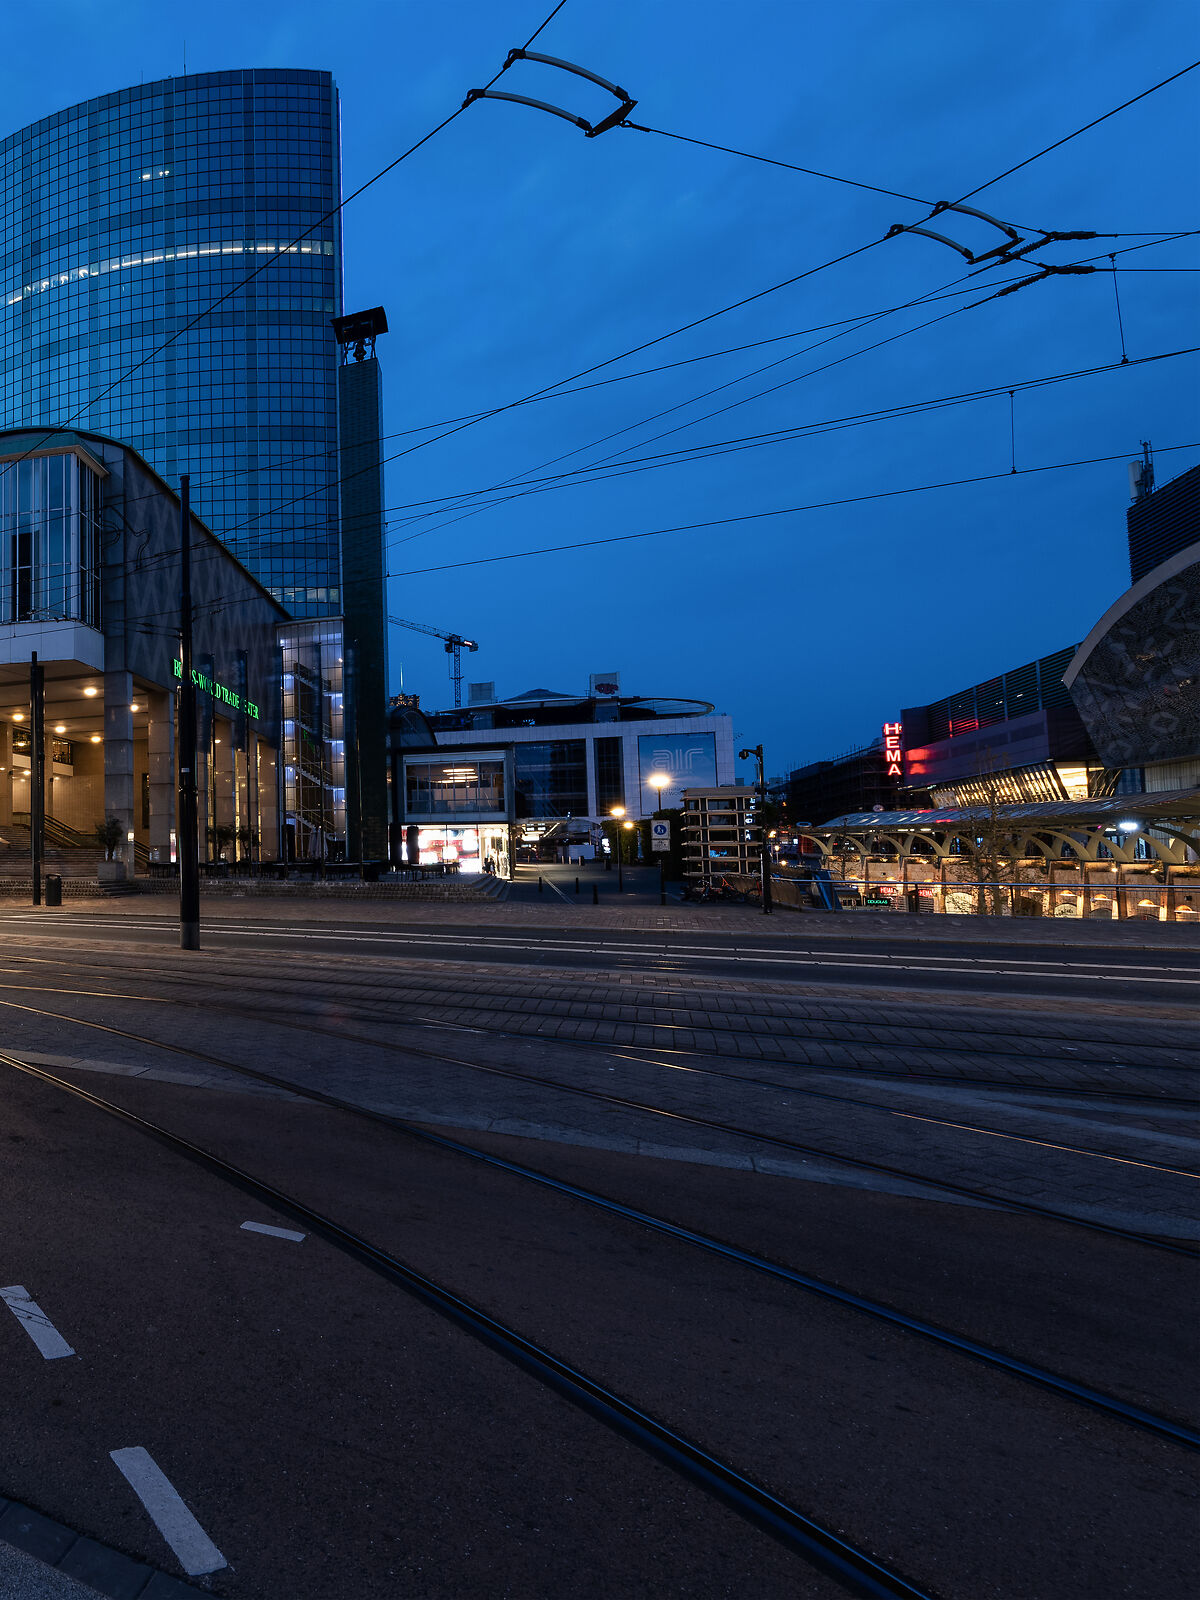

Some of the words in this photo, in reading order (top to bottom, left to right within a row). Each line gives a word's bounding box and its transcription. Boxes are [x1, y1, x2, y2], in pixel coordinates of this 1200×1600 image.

[221, 686, 241, 709] TRADE
[652, 748, 704, 771] air
[884, 722, 902, 776] HEMA
